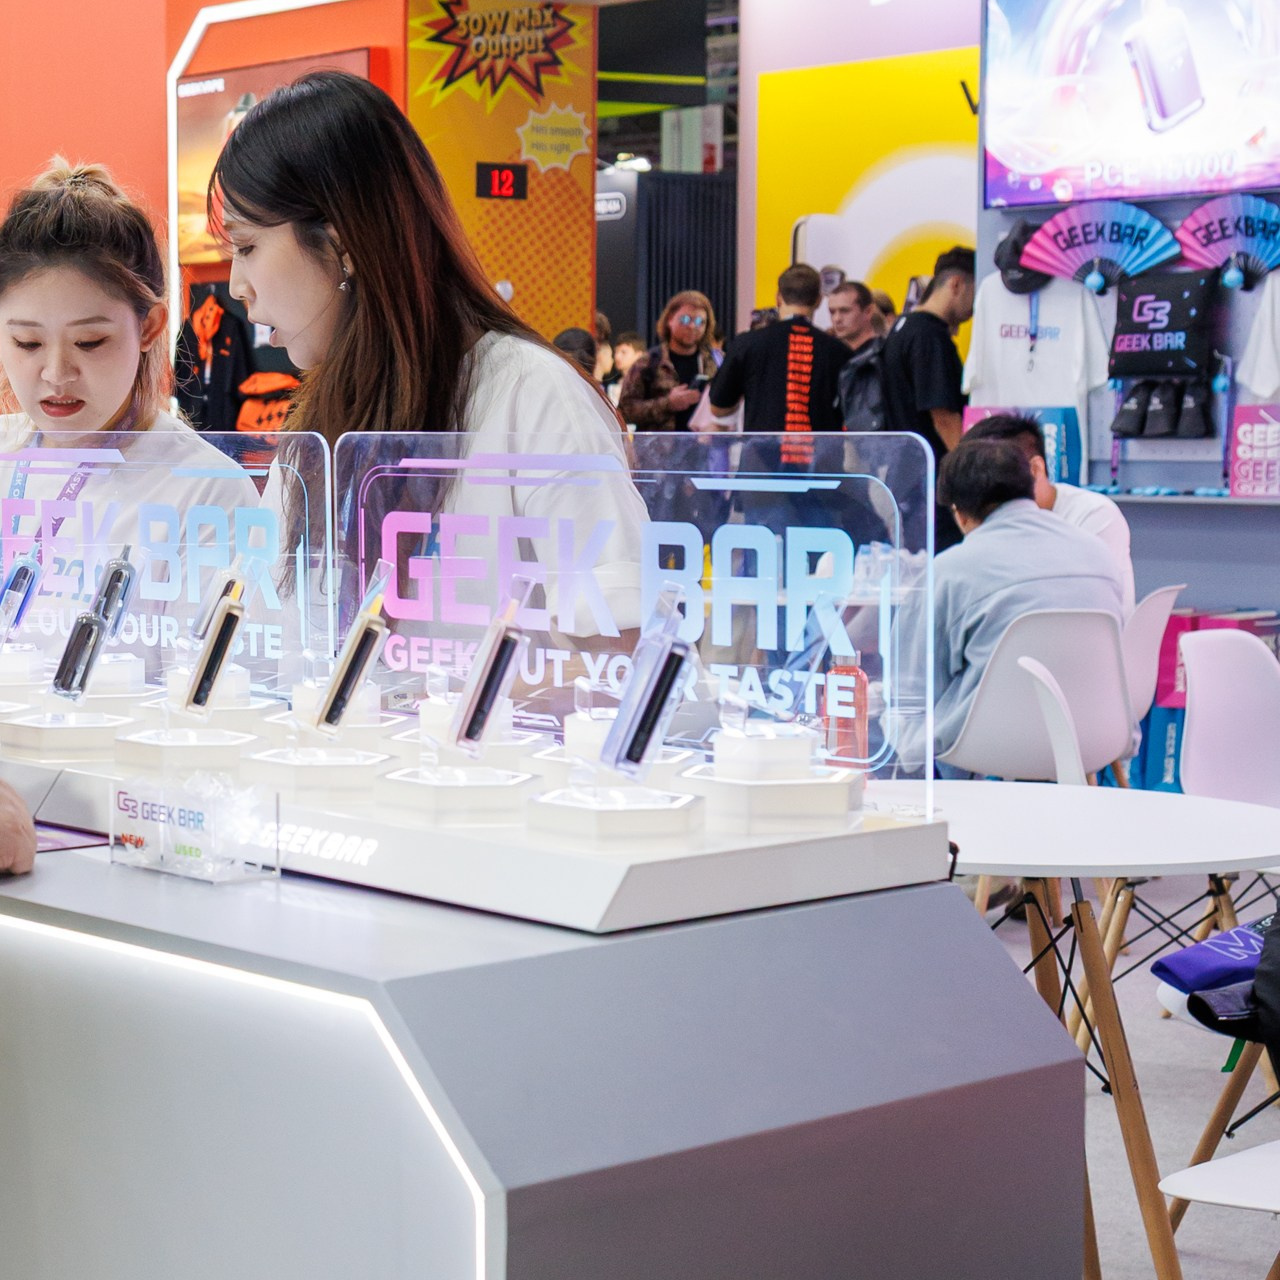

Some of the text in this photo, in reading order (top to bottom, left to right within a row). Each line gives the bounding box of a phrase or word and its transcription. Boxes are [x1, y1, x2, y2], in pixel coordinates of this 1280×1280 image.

[511, 5, 557, 34] Max
[472, 28, 546, 61] Output
[490, 169, 514, 197] 12
[1115, 331, 1186, 352] GEEK BAR
[138, 503, 282, 611] BAR
[382, 511, 857, 657] GEEK BAR
[710, 664, 856, 719] TASTE
[141, 802, 176, 825] GEEK
[178, 808, 205, 831] BAR
[120, 832, 145, 848] NEW
[174, 842, 203, 859] USED
